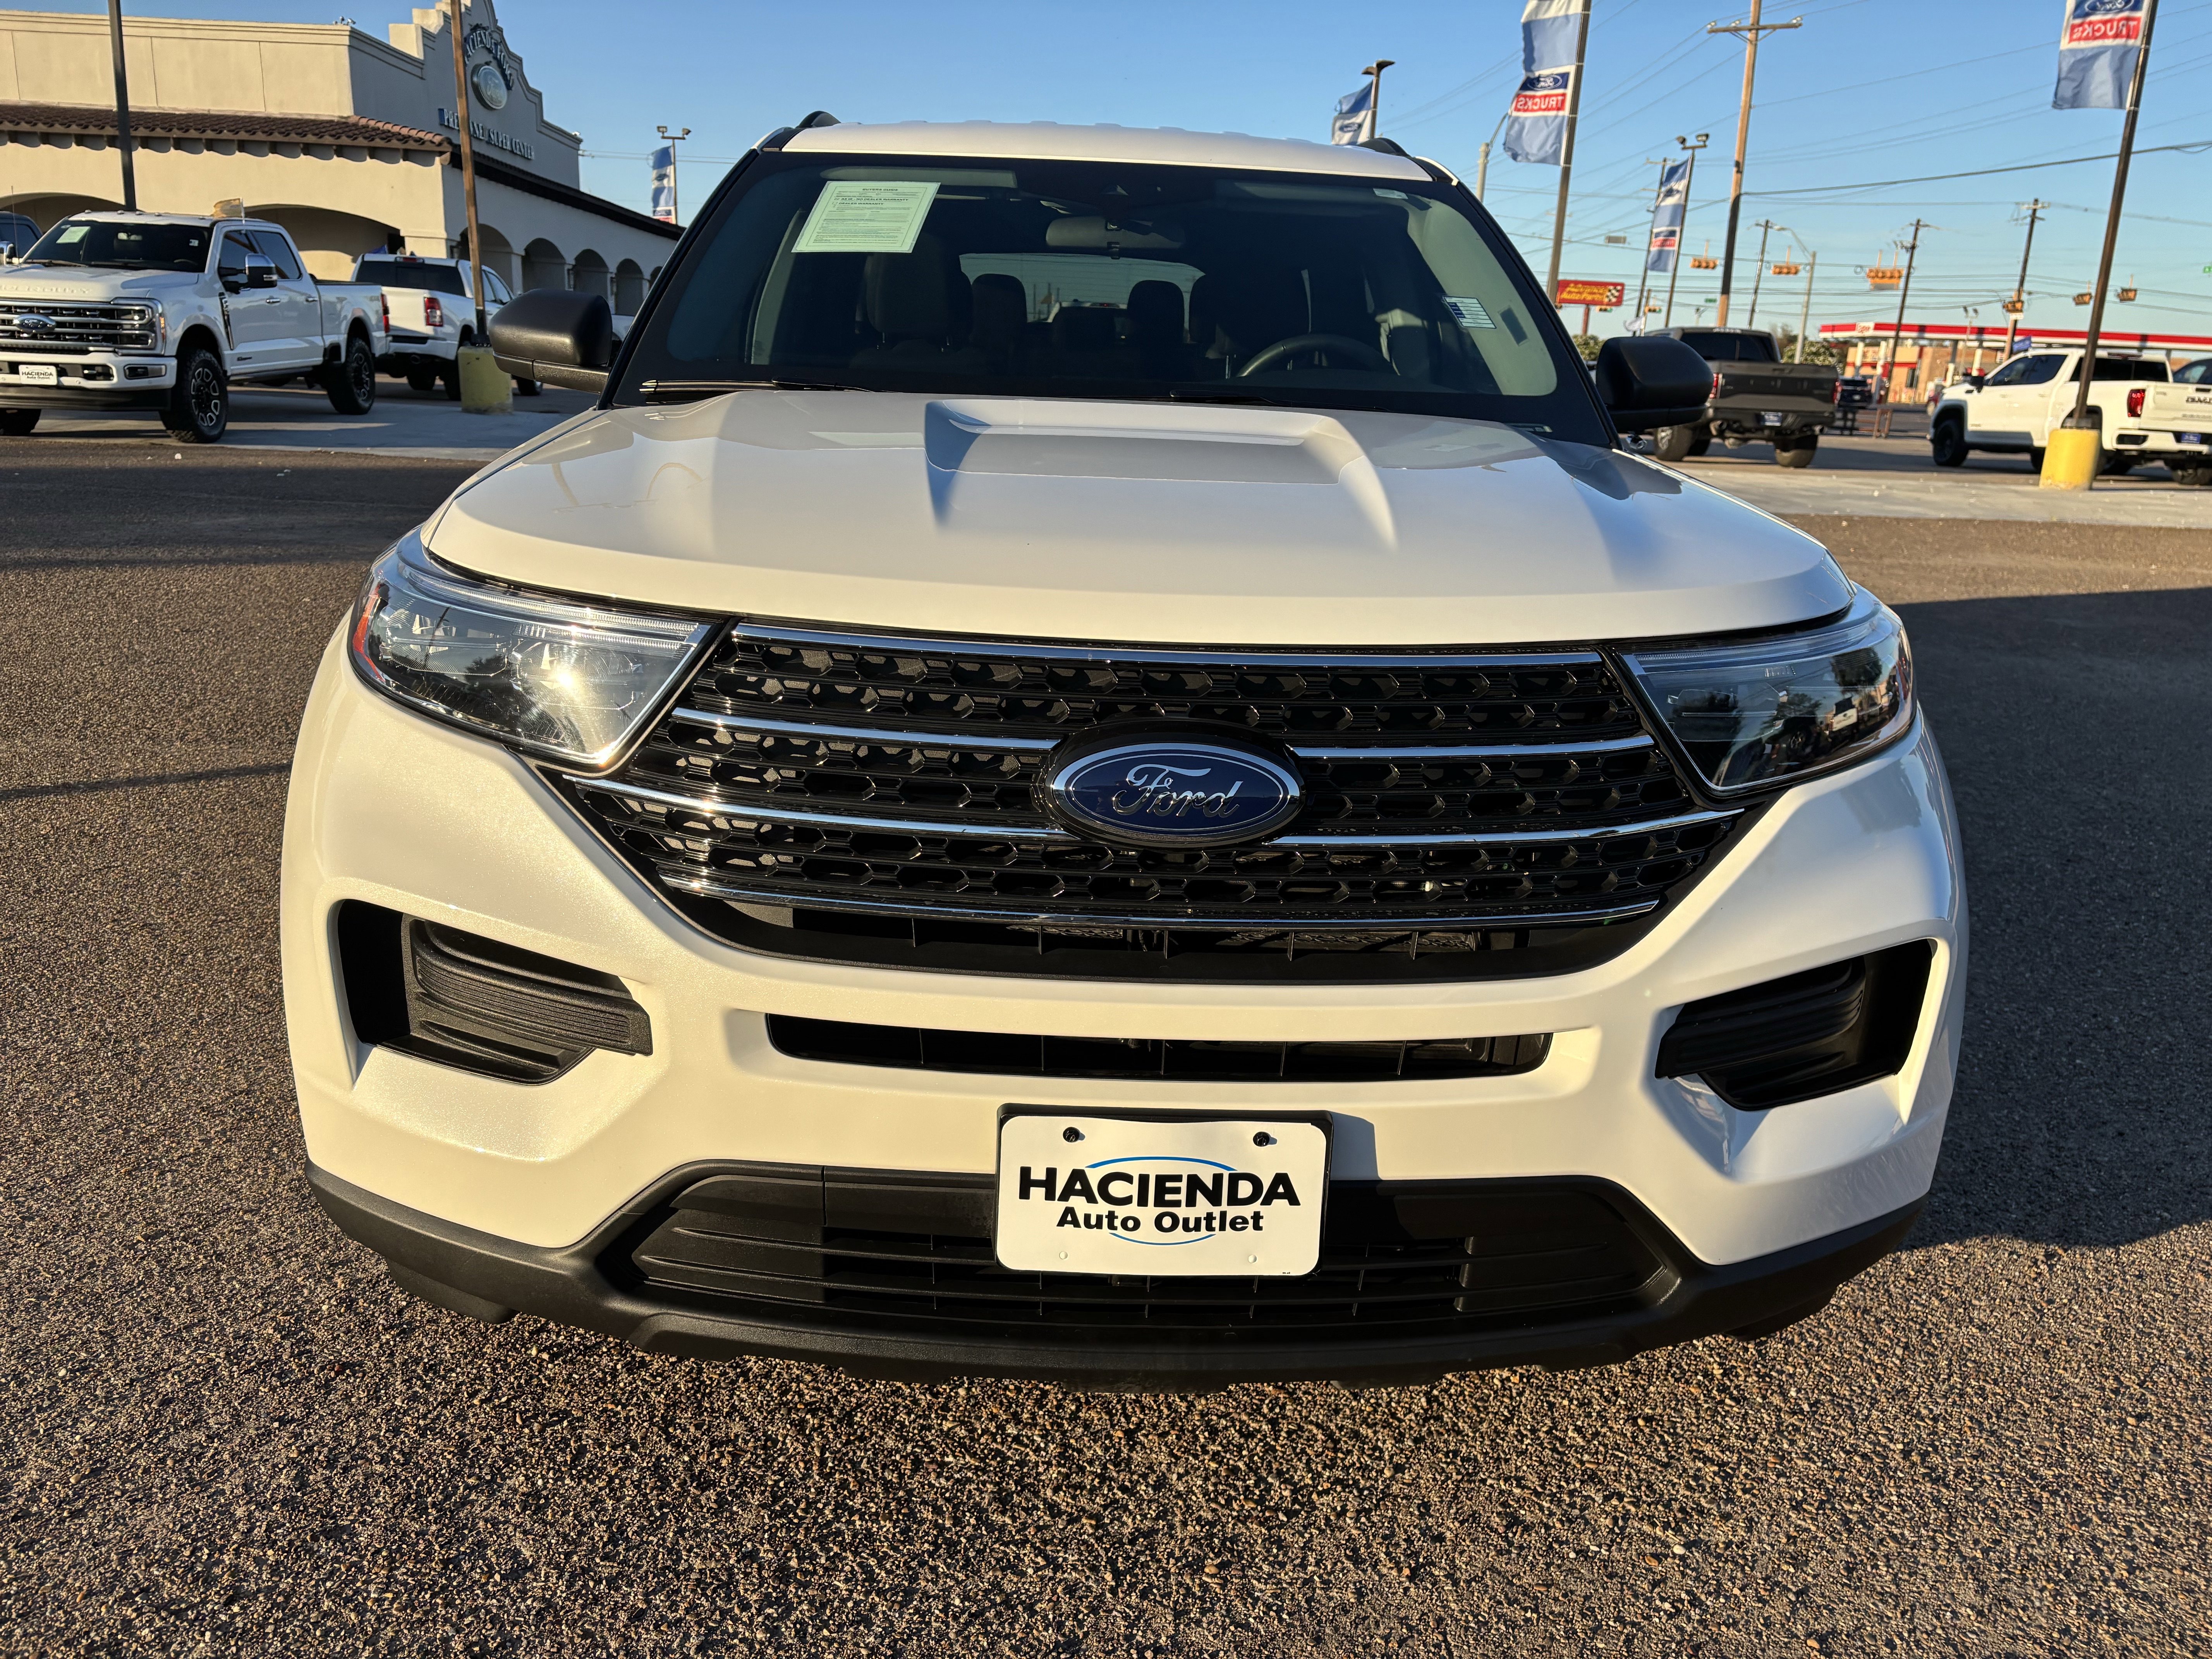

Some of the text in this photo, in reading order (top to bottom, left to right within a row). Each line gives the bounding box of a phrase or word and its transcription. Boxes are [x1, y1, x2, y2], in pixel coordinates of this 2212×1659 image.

[489, 128, 511, 151] SUPER
[512, 138, 535, 160] CENTER
[1113, 763, 1243, 818] Ford
[1019, 1166, 1301, 1207] HACIENDA
[1056, 1206, 1264, 1233] Auto Outlet
